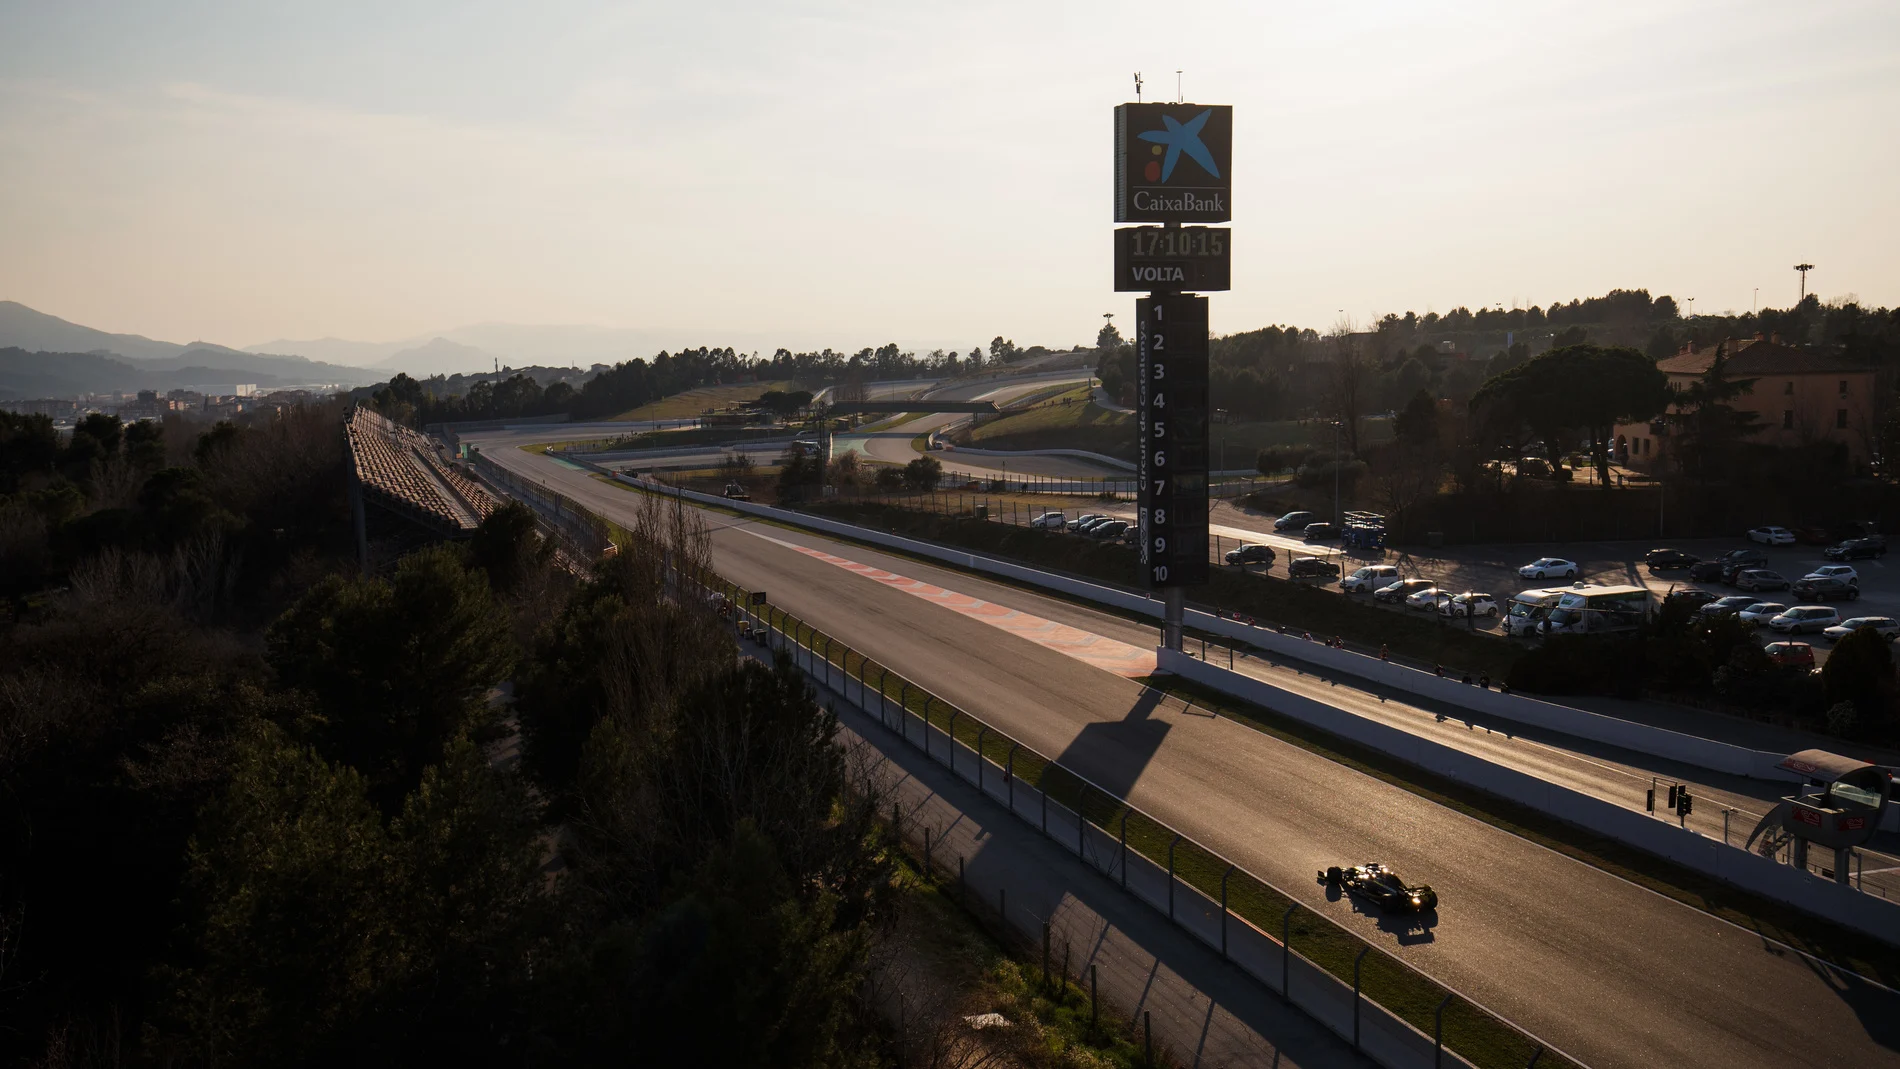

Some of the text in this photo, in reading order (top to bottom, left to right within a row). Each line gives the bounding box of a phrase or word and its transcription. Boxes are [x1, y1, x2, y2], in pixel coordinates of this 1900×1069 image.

[1133, 190, 1225, 212] CaixaBank
[1132, 231, 1224, 256] 17:10:15
[1132, 266, 1185, 281] VOLTA
[1153, 304, 1164, 321] 1
[1153, 333, 1165, 351] 2
[1153, 363, 1166, 380] 3
[1139, 320, 1147, 492] Circuit de Catalunya
[1153, 392, 1166, 409] 4
[1154, 421, 1166, 438] 5
[1154, 450, 1166, 467] 6
[1154, 480, 1166, 496] 7
[1154, 508, 1167, 525] 8
[1154, 537, 1166, 554] 9
[1152, 565, 1169, 582] 10
